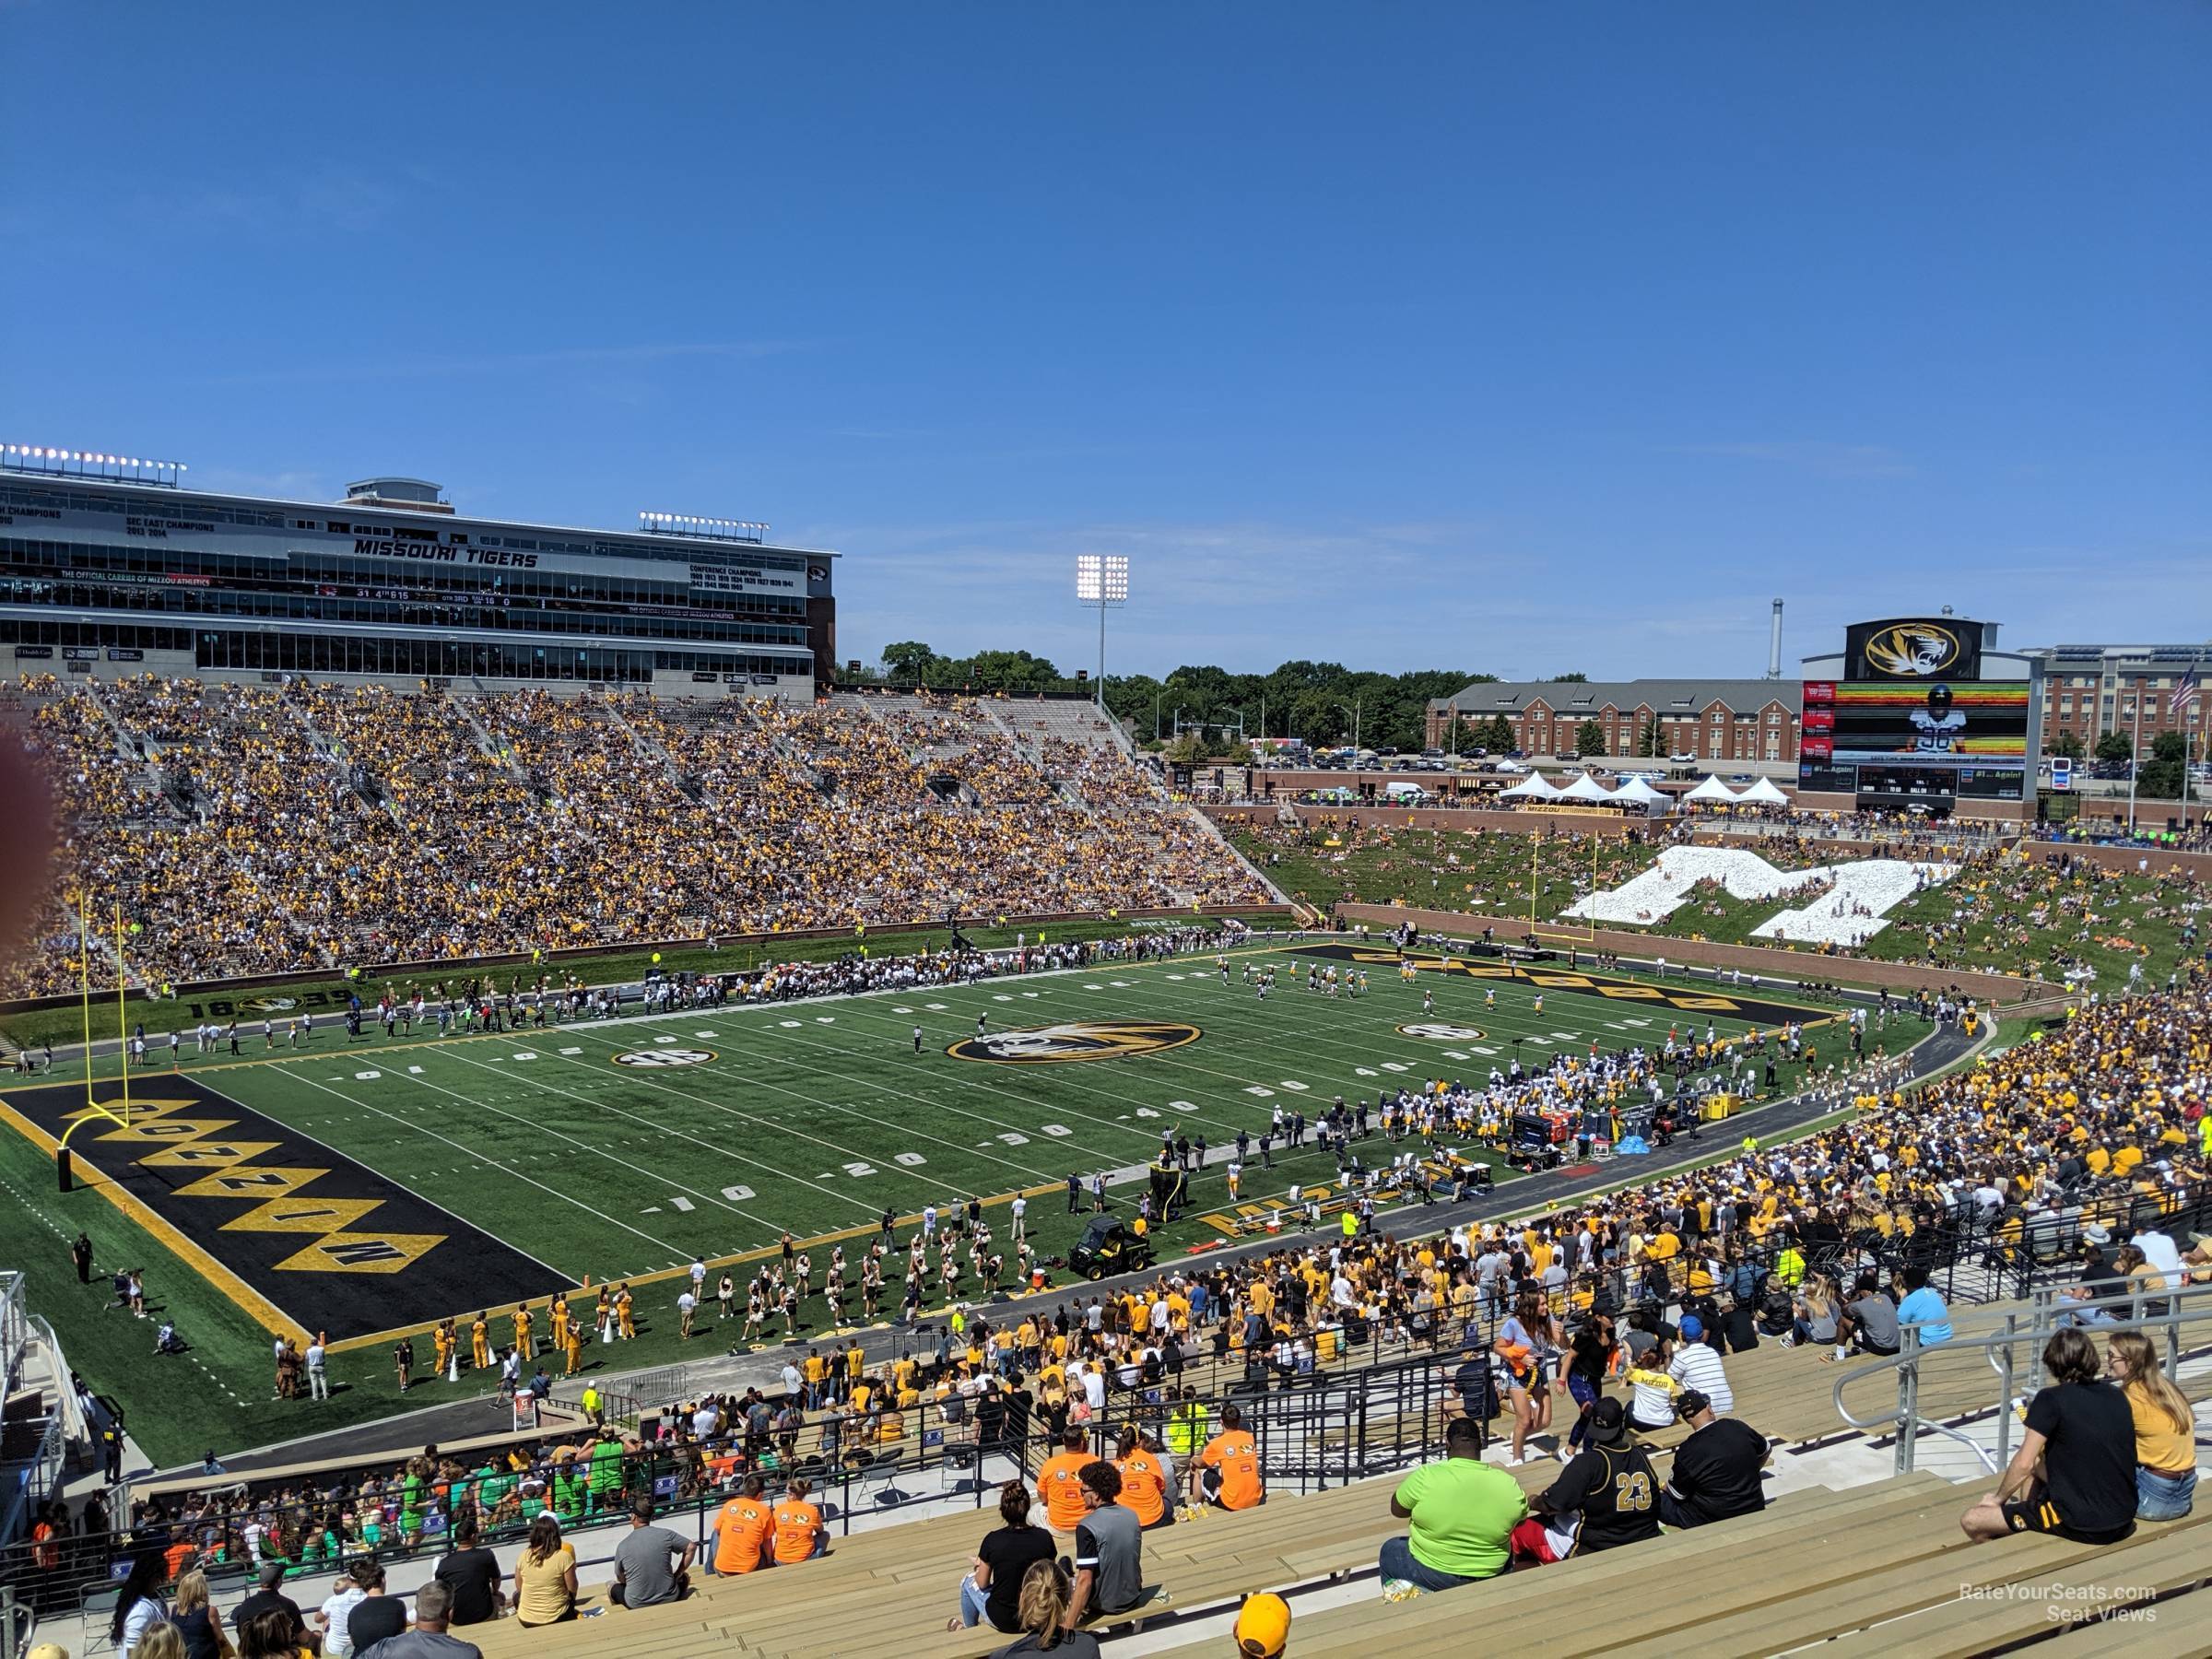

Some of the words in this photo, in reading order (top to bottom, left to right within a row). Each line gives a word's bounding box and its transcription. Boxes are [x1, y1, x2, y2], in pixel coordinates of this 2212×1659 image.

[126, 517, 141, 526] SEC
[144, 518, 164, 528] EAST
[166, 520, 215, 533] CHAMPIONS
[354, 539, 457, 561] MISSOURI
[466, 549, 538, 568] TIGERS
[76, 571, 106, 581] OFFICIAL
[147, 575, 177, 584] MIZZOU
[177, 577, 210, 586] ATHLETICS
[1641, 1378, 1668, 1388] MIZZOU
[1617, 1471, 1652, 1512] 23
